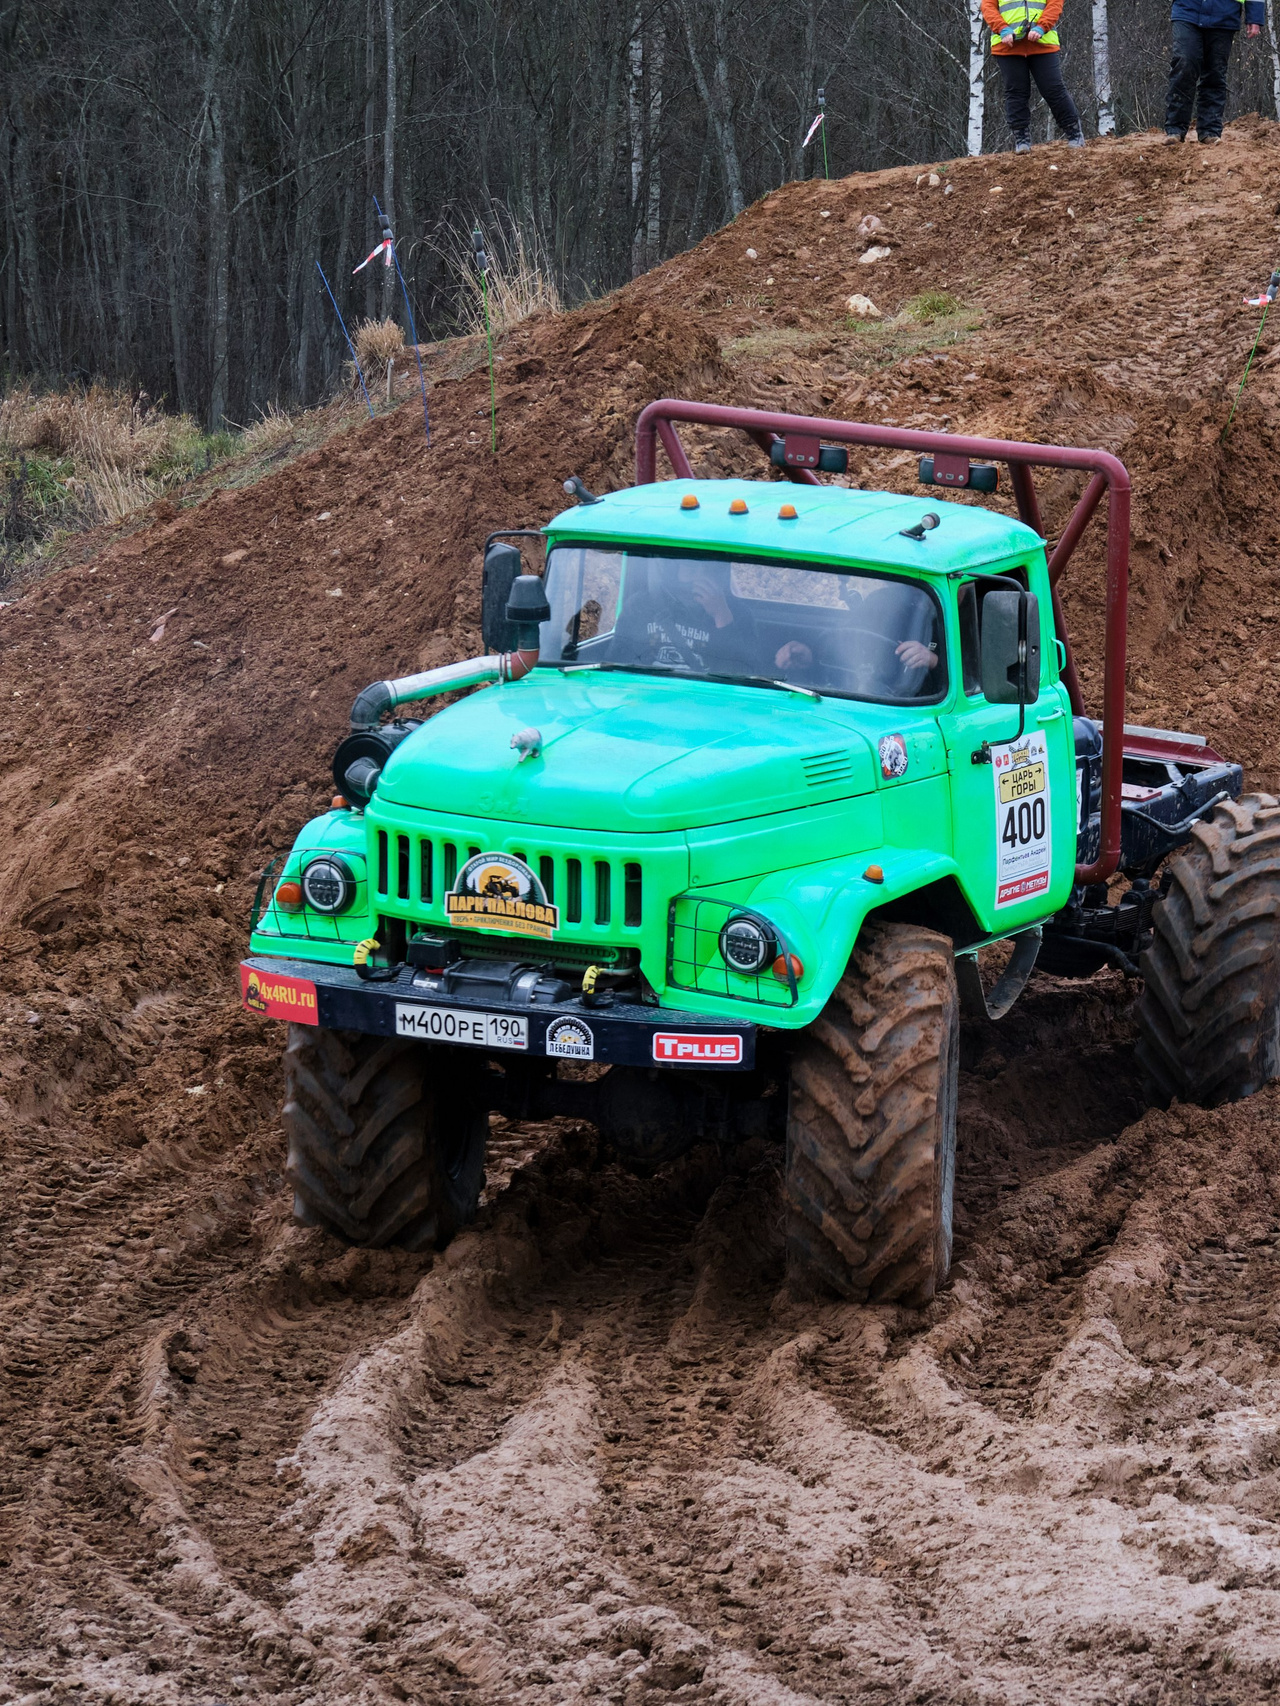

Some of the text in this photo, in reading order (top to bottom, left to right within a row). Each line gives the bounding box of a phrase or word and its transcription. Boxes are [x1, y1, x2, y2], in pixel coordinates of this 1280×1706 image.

[1012, 769, 1033, 784] ЦАРЬ
[1011, 779, 1036, 797] ГОРЫ
[1002, 797, 1045, 848] 400
[449, 895, 555, 924] ПАРК ПАВЛОВА
[261, 982, 315, 1008] 4x4RU.ru
[490, 1018, 520, 1037] 190
[497, 1035, 513, 1044] RUS
[549, 1043, 590, 1056] ЛЕБЕДУШКА
